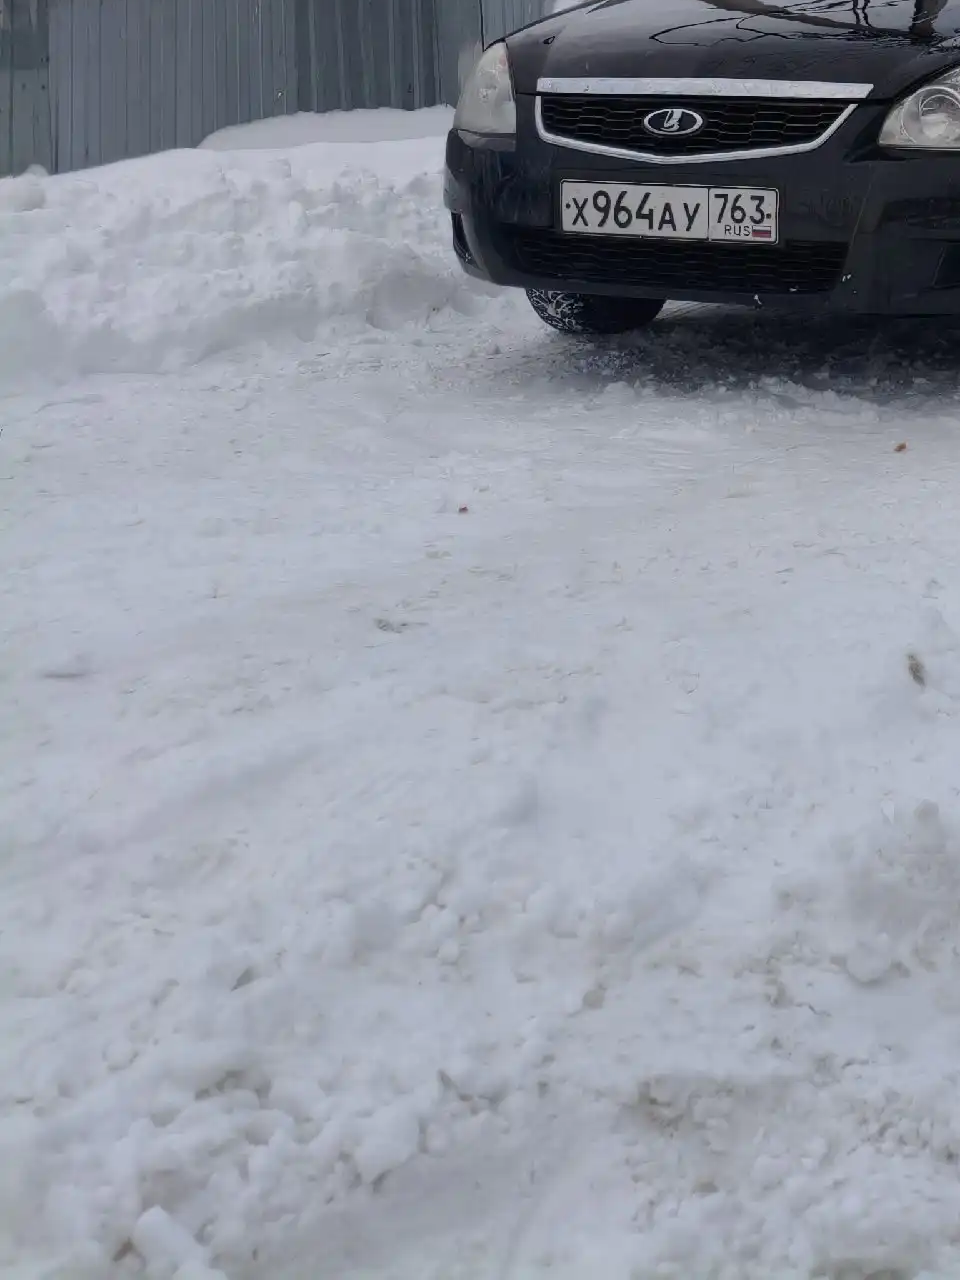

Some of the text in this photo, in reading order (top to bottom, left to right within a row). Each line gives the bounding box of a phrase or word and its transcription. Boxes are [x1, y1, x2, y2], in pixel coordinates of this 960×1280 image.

[571, 190, 765, 232] Х964АУ 763
[724, 224, 751, 237] RUS
